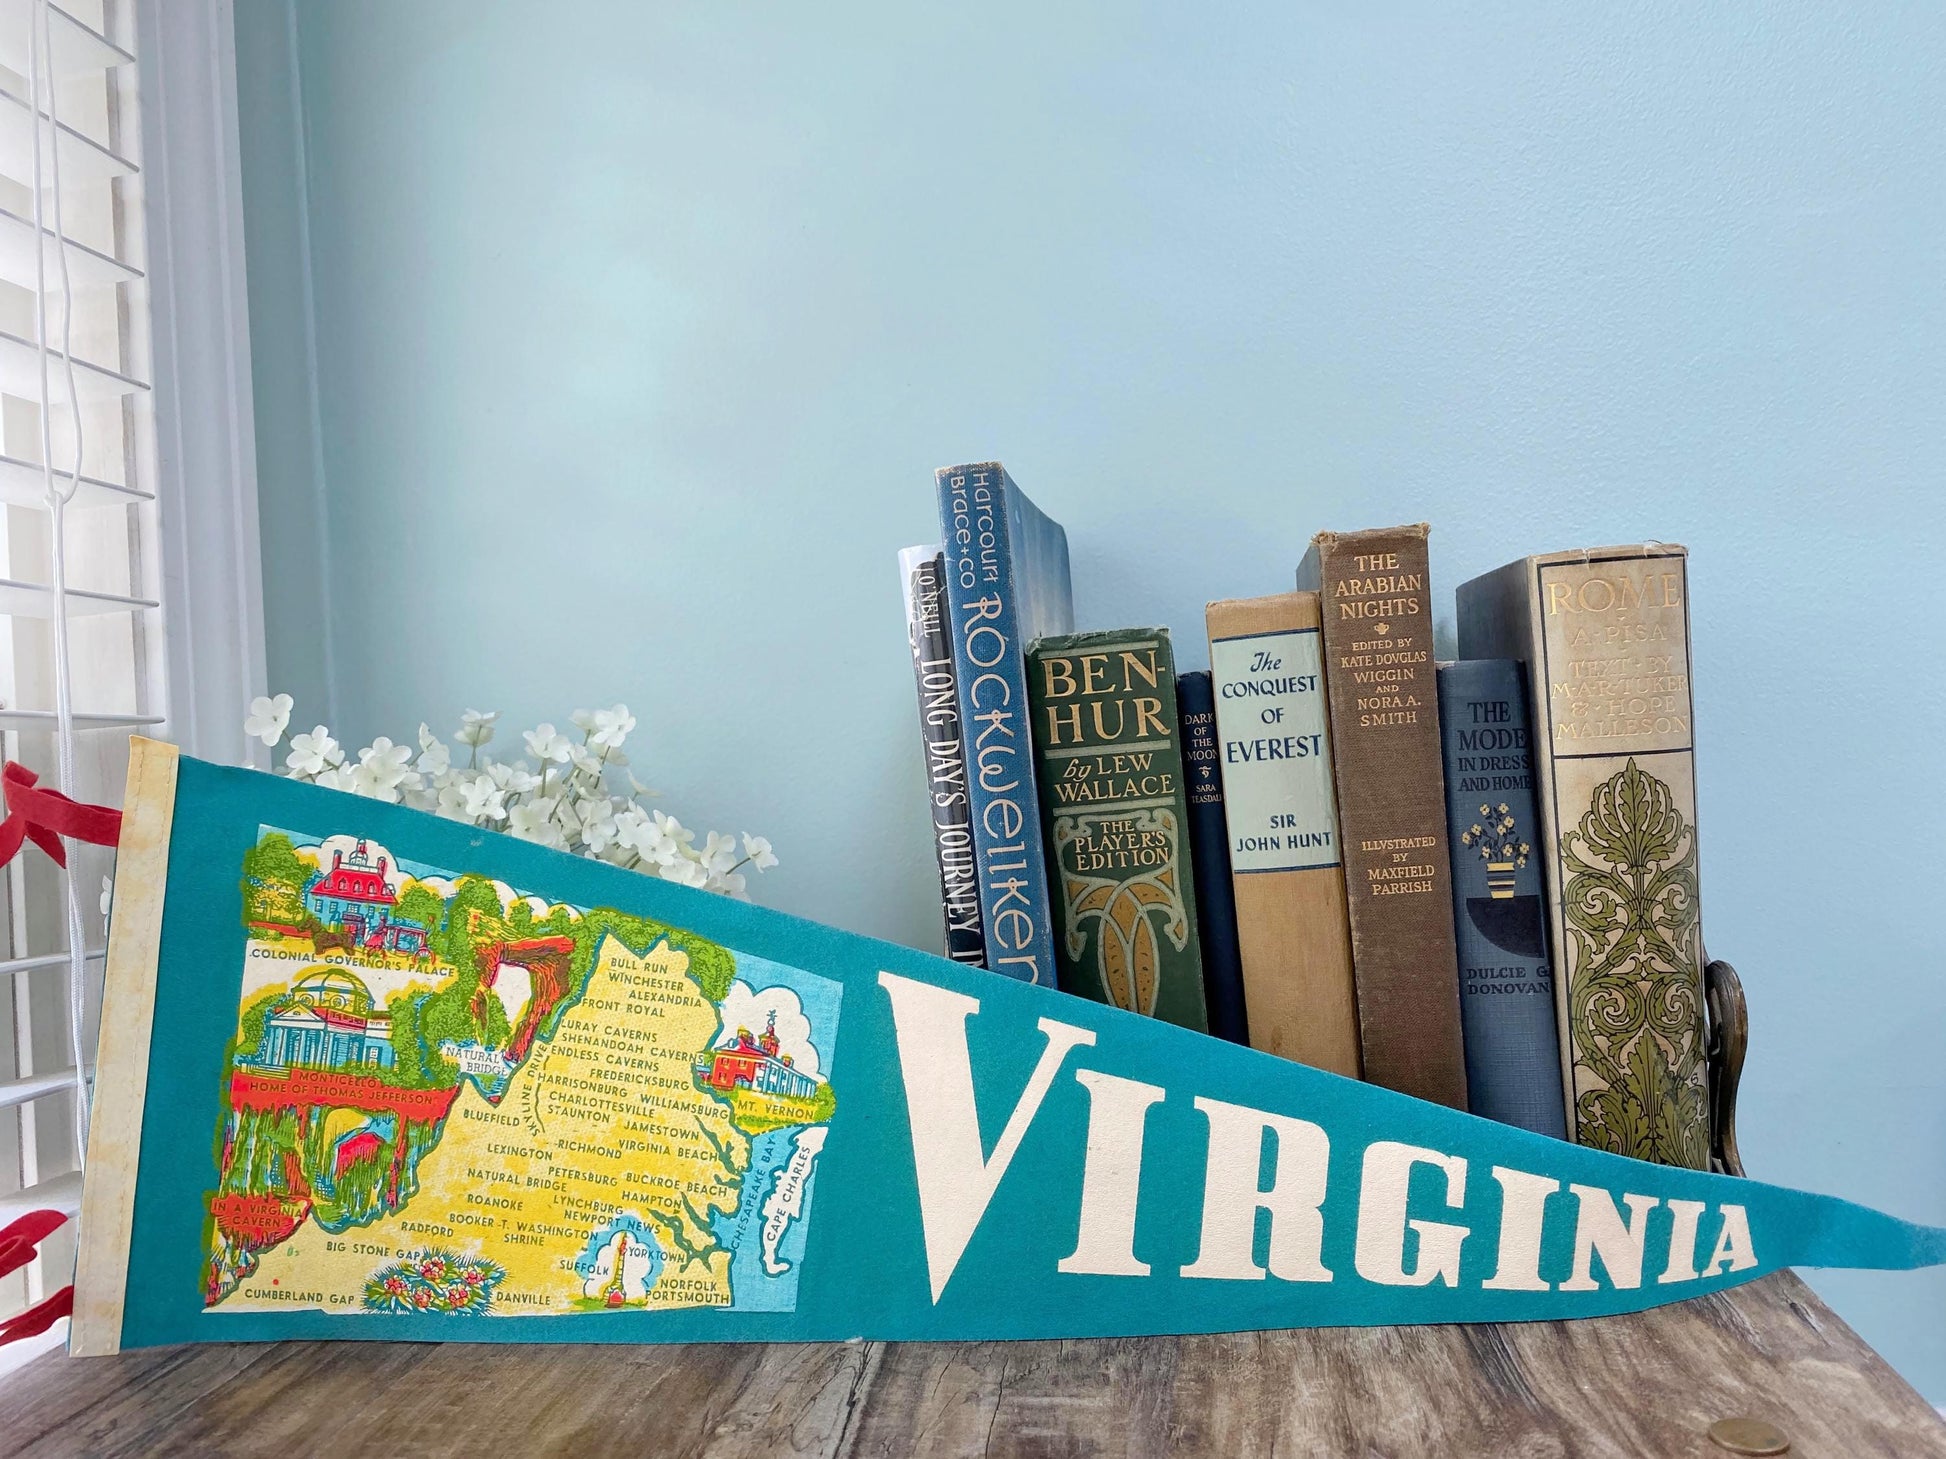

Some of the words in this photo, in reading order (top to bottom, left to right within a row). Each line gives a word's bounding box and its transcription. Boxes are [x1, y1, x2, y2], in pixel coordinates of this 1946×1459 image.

[973, 474, 998, 582] Harcourt
[1354, 553, 1399, 572] THE
[1335, 574, 1422, 597] ARABIAN
[1547, 574, 1681, 616] ROME
[1340, 598, 1419, 619] NIGHTS
[1352, 639, 1392, 651] EDITED
[1397, 637, 1412, 647] BY
[1250, 652, 1282, 672] The
[1341, 655, 1373, 668] KATE
[1041, 650, 1166, 699] BEN-
[1354, 668, 1414, 684] WIGGIN
[920, 657, 959, 726] LONG
[1222, 675, 1317, 698] CONQUEST
[1357, 697, 1401, 710] NORA
[1405, 695, 1422, 706] A.
[1467, 701, 1511, 723] THE
[1609, 696, 1676, 716] HOPE
[1046, 697, 1172, 744] HUR
[1185, 713, 1215, 725] DARK
[1261, 708, 1284, 724] OF
[1360, 711, 1417, 727] SMITH
[1194, 726, 1207, 736] OF
[1556, 716, 1688, 740] MALLESON
[1192, 738, 1213, 747] THE
[1226, 734, 1322, 763] EVEREST
[1458, 728, 1526, 751] MODE
[928, 738, 966, 808] DAY'S
[1063, 758, 1092, 782] by
[1096, 753, 1153, 775] LEW
[1458, 757, 1478, 772] IN
[1480, 755, 1530, 771] DRESS
[1054, 774, 1176, 802] WALLACE
[1196, 784, 1216, 792] SARA
[1458, 776, 1490, 792] AND
[1493, 775, 1531, 790] HOME
[1100, 820, 1134, 834] THE
[1270, 814, 1297, 828] SIR
[1074, 831, 1166, 853] PLAYER'S
[1236, 836, 1280, 852] JOHN
[1288, 832, 1331, 848] HUNT
[1076, 847, 1170, 871] EDITION
[1393, 853, 1408, 863] BY
[936, 821, 981, 934] JOURNEY
[1368, 865, 1435, 880] MAXFIELD
[1372, 881, 1433, 895] PARRISH
[251, 949, 317, 963] COLONIAL
[325, 955, 401, 971] GOVERNOR'S
[408, 964, 455, 977] PALACE
[611, 958, 639, 971] BULL
[644, 961, 668, 974] RUN
[1467, 967, 1526, 979] DULCIE
[609, 973, 684, 992] WINCHESTER
[1468, 982, 1549, 995] DONOVAN
[582, 998, 619, 1012] FRONT
[627, 1002, 665, 1017] ROYAL
[629, 990, 702, 1008] ALEXANDRIA
[561, 1019, 596, 1033] LURAY
[604, 1025, 657, 1042] CAVERNS
[446, 1047, 500, 1063] NATURAL
[551, 1045, 599, 1061] ENDLESS
[606, 1054, 659, 1071] CAVERNS
[562, 1033, 644, 1054] SHENANDOAH
[651, 1047, 703, 1064] CAVERNS
[528, 1044, 548, 1078] DRIVE
[300, 1072, 376, 1088] MONTICELLO
[538, 1073, 628, 1097] HARRISONBURG
[590, 1069, 689, 1090] FREDERICKSBURG
[250, 1082, 286, 1093] HOME
[292, 1084, 308, 1094] OF
[313, 1085, 363, 1098] THOMAS
[369, 1090, 432, 1104] JEFFERSON
[522, 1084, 540, 1136] SKYLINE
[548, 1105, 610, 1122] STAUNTON
[549, 1092, 655, 1118] CHARLOTTESVILLE
[640, 1094, 729, 1119] WILLIAMSBURG
[738, 1100, 757, 1112] MT.
[765, 1105, 814, 1120] VERNON
[463, 1109, 520, 1126] BLUEFIELD
[624, 1121, 700, 1140] JAMESTOWN
[877, 971, 1758, 1307] VIRGINIA
[488, 1144, 552, 1160] LEXINGTON
[618, 1139, 671, 1156] VIRGINIA
[678, 1148, 718, 1161] BEACH
[467, 1168, 520, 1185] NATURAL
[527, 1177, 567, 1192] BRIDGE
[548, 1166, 618, 1187] PETERSBURG
[626, 1172, 680, 1190] BUCKROE
[687, 1182, 727, 1197] BEACH
[467, 1194, 523, 1211] ROANOKE
[622, 1191, 682, 1209] HAMPTON
[731, 1168, 766, 1250] CHESAPEAKE
[762, 1137, 776, 1164] BAY
[767, 1208, 786, 1241] CAPE
[783, 1146, 810, 1202] CHARLES
[214, 1202, 226, 1211] IN
[234, 1204, 241, 1212] A
[250, 1205, 302, 1217] VIRGINIA
[553, 1195, 624, 1215] LYNCHBURG
[233, 1217, 280, 1227] CAVERN
[401, 1221, 454, 1237] RADFORD
[449, 1213, 494, 1227] BOOKER
[517, 1222, 598, 1240] WASHINGTON
[564, 1210, 620, 1227] NEWPORT
[627, 1220, 661, 1234] NEWS
[504, 1234, 545, 1246] SHRINE
[326, 1241, 346, 1252] BIG
[354, 1243, 390, 1257] STONE
[396, 1247, 420, 1261] GAP
[629, 1247, 685, 1263] YORKTOWN
[559, 1259, 609, 1275] SUFFOLK
[661, 1279, 717, 1292] NORFOLK
[244, 1288, 323, 1303] CUMBERLAND
[329, 1294, 354, 1305] GAP
[496, 1292, 550, 1305] DANVILLE
[646, 1290, 729, 1304] PORTSMOUTH
